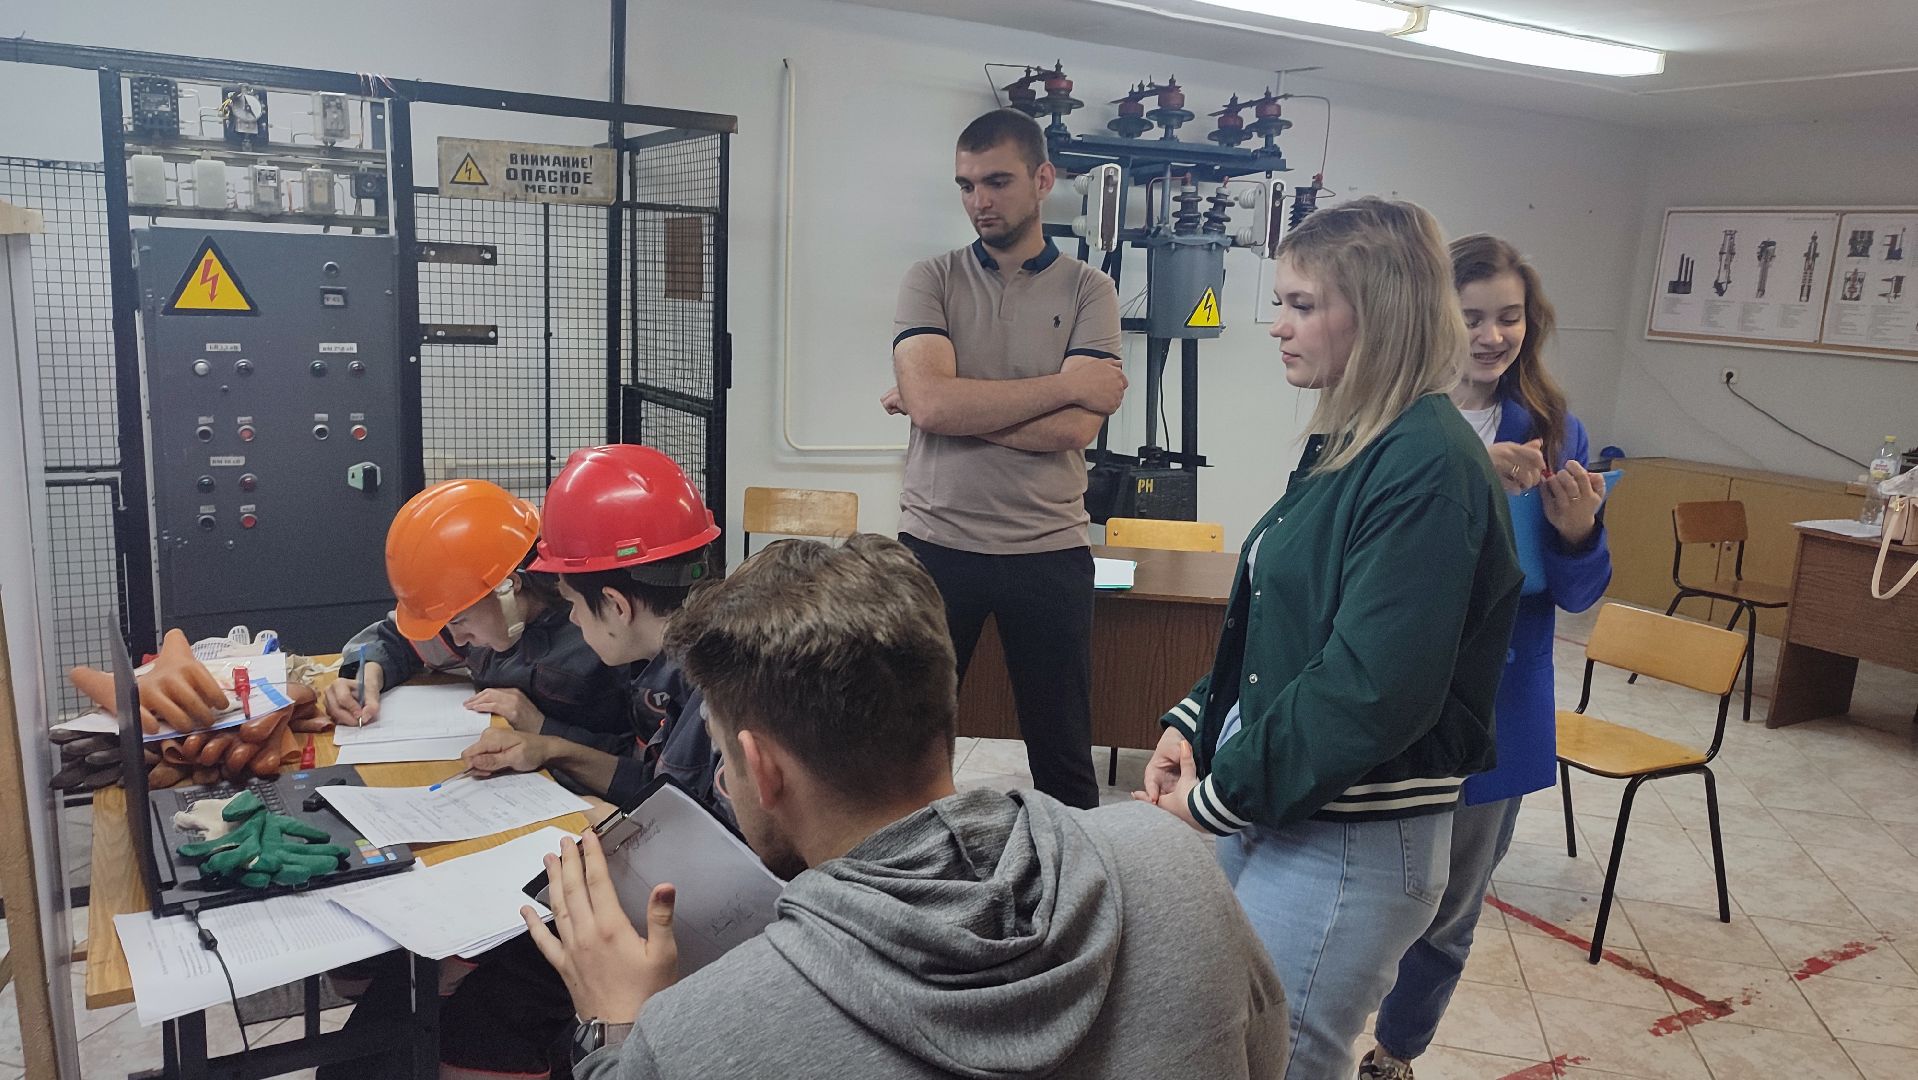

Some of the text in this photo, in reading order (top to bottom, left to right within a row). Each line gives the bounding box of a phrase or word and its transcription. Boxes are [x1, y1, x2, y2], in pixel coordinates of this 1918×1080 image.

[509, 153, 593, 169] ВНИМАНИЕ!
[505, 167, 593, 185] ОПАСНОЕ
[524, 184, 579, 196] МЕСТО
